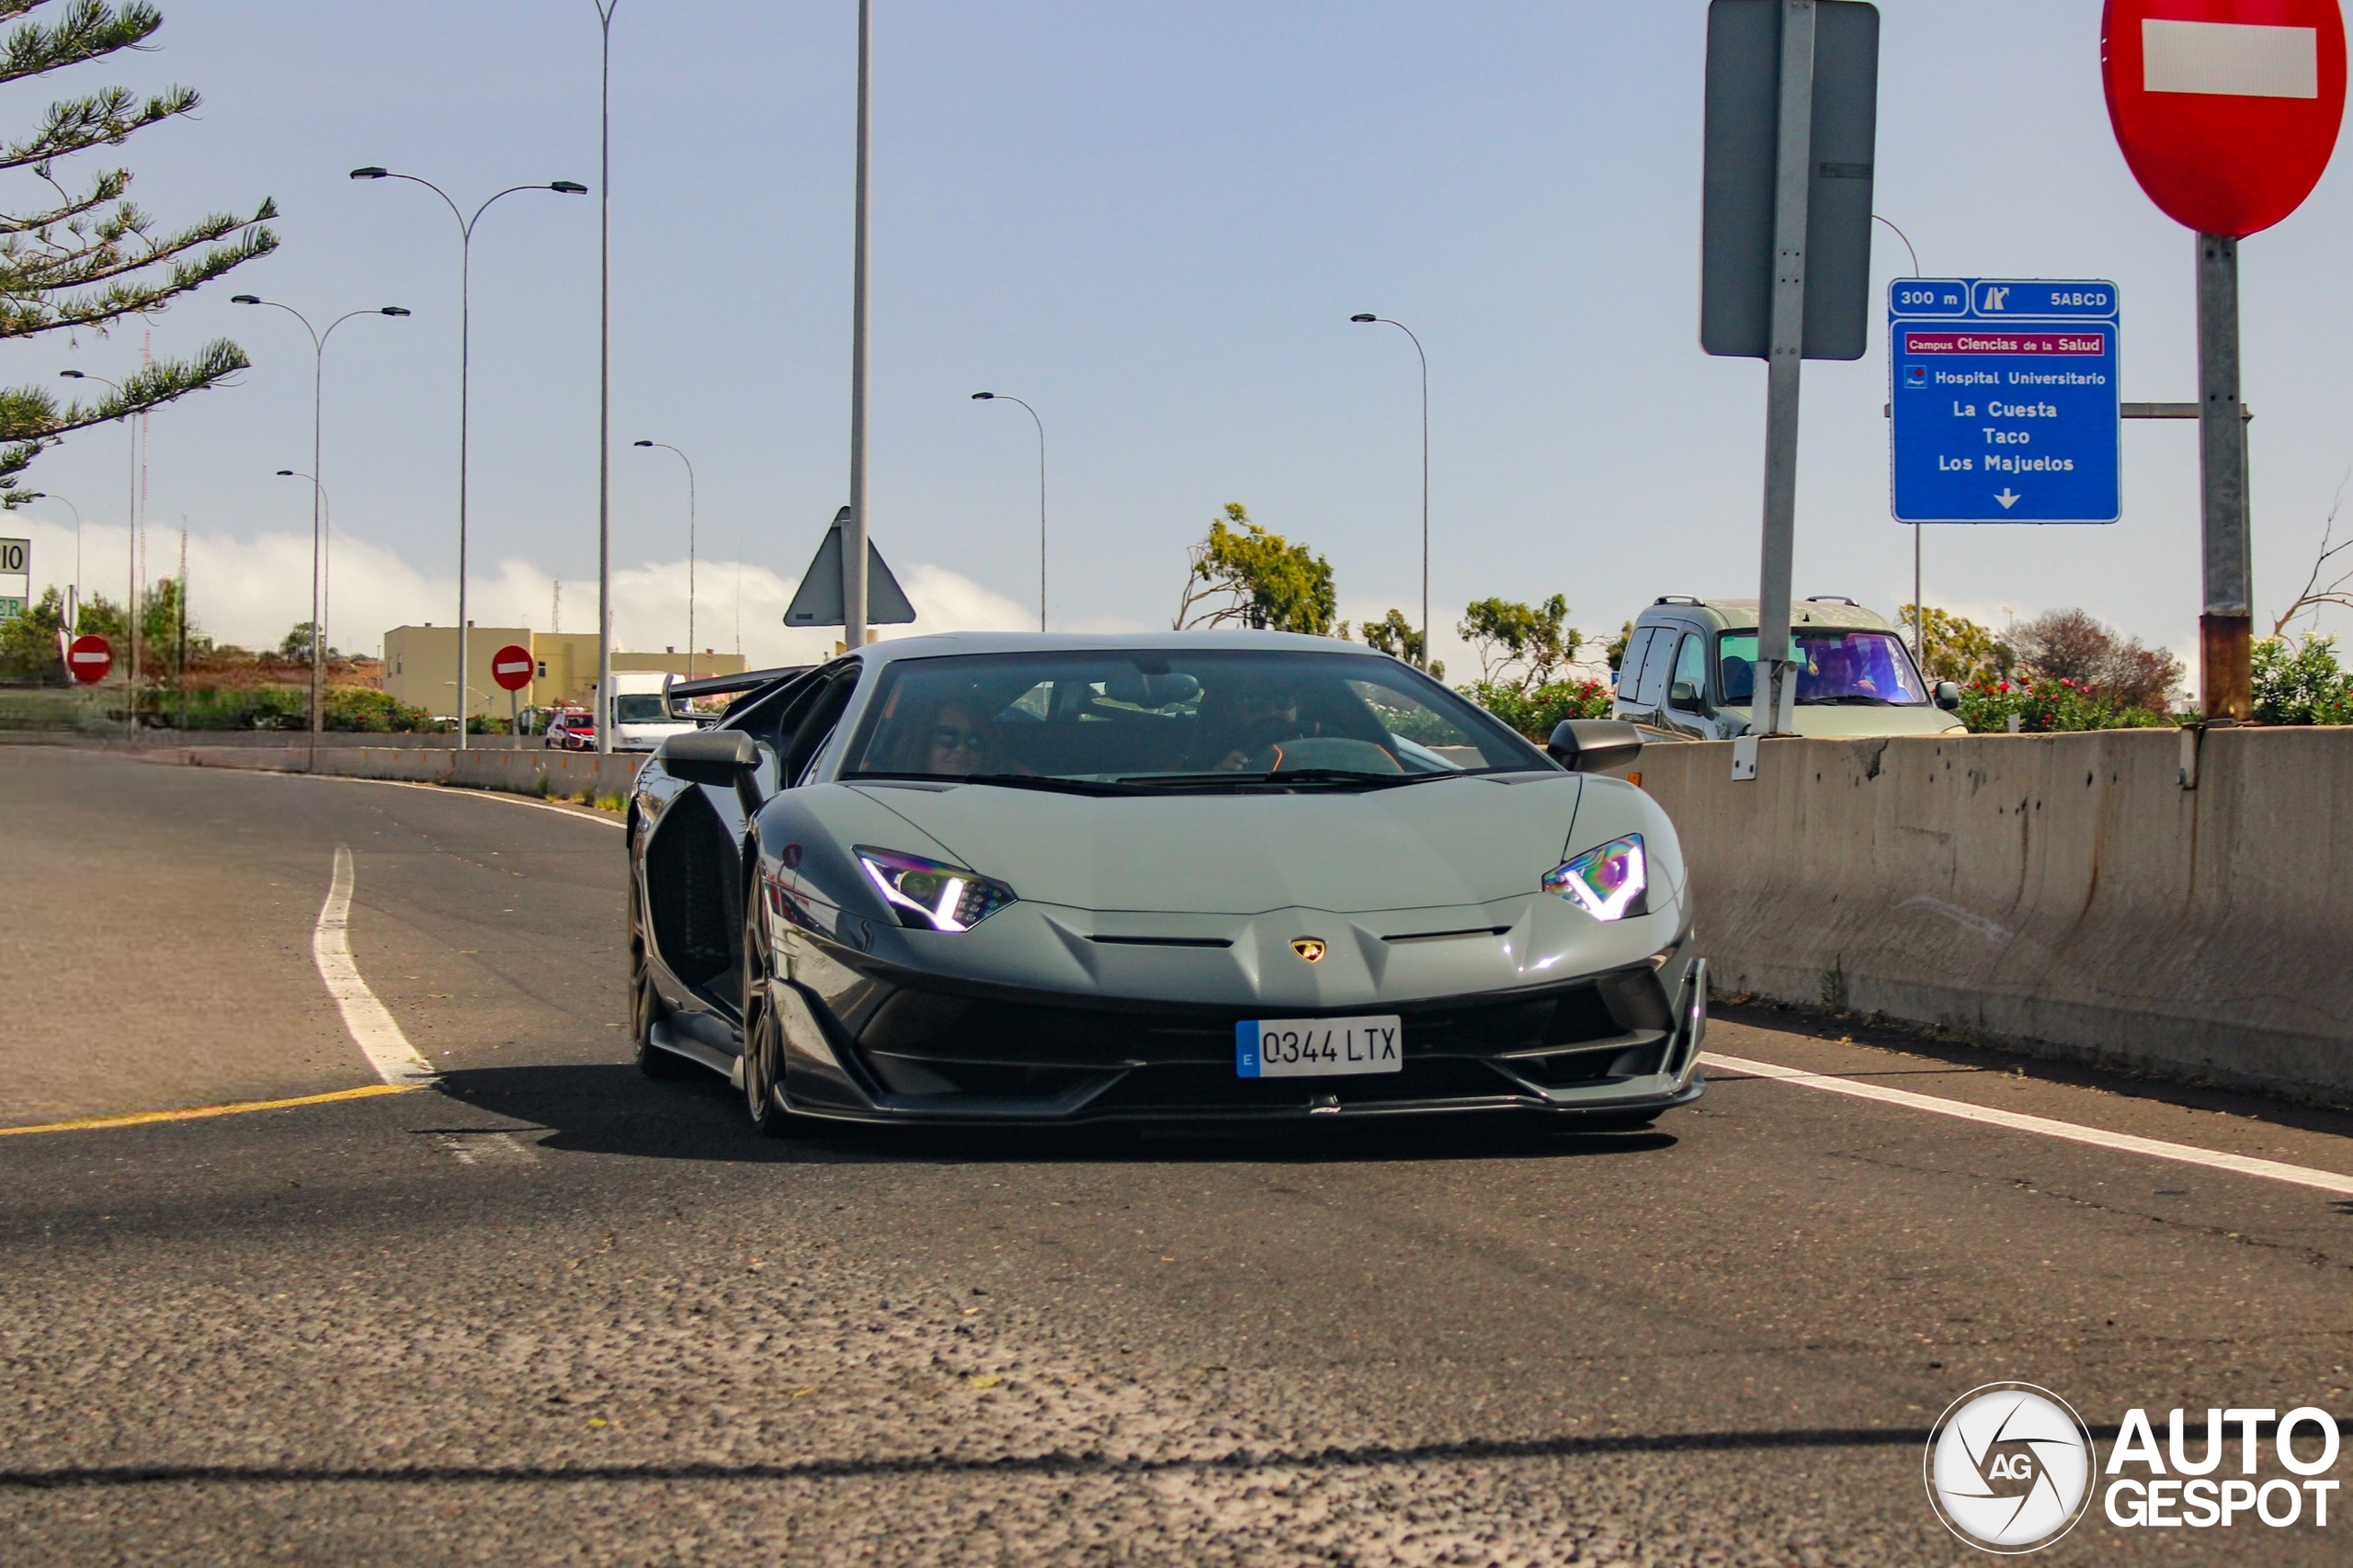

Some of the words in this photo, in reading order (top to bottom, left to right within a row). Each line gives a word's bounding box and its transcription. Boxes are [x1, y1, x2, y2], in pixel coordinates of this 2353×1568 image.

[1901, 290, 1935, 304] 300
[1943, 294, 1958, 306] m
[2051, 292, 2108, 306] 5ABCD
[1908, 339, 1954, 352] Campus
[1957, 336, 2018, 351] Ciencias
[2023, 341, 2038, 351] de
[2041, 341, 2053, 351] la
[2058, 337, 2100, 351] Salud
[1936, 371, 2000, 386] Hospital
[2008, 371, 2106, 385] Universitario
[1953, 401, 1976, 416] La
[1988, 401, 2057, 417] Cuesta
[1983, 427, 2030, 444] Taco
[1939, 455, 1973, 472] Los
[1984, 455, 2075, 474] Majuelos
[0, 545, 23, 569] IO
[1263, 1030, 1337, 1064] 0344
[1347, 1028, 1396, 1062] LTX
[1243, 1053, 1253, 1066] E
